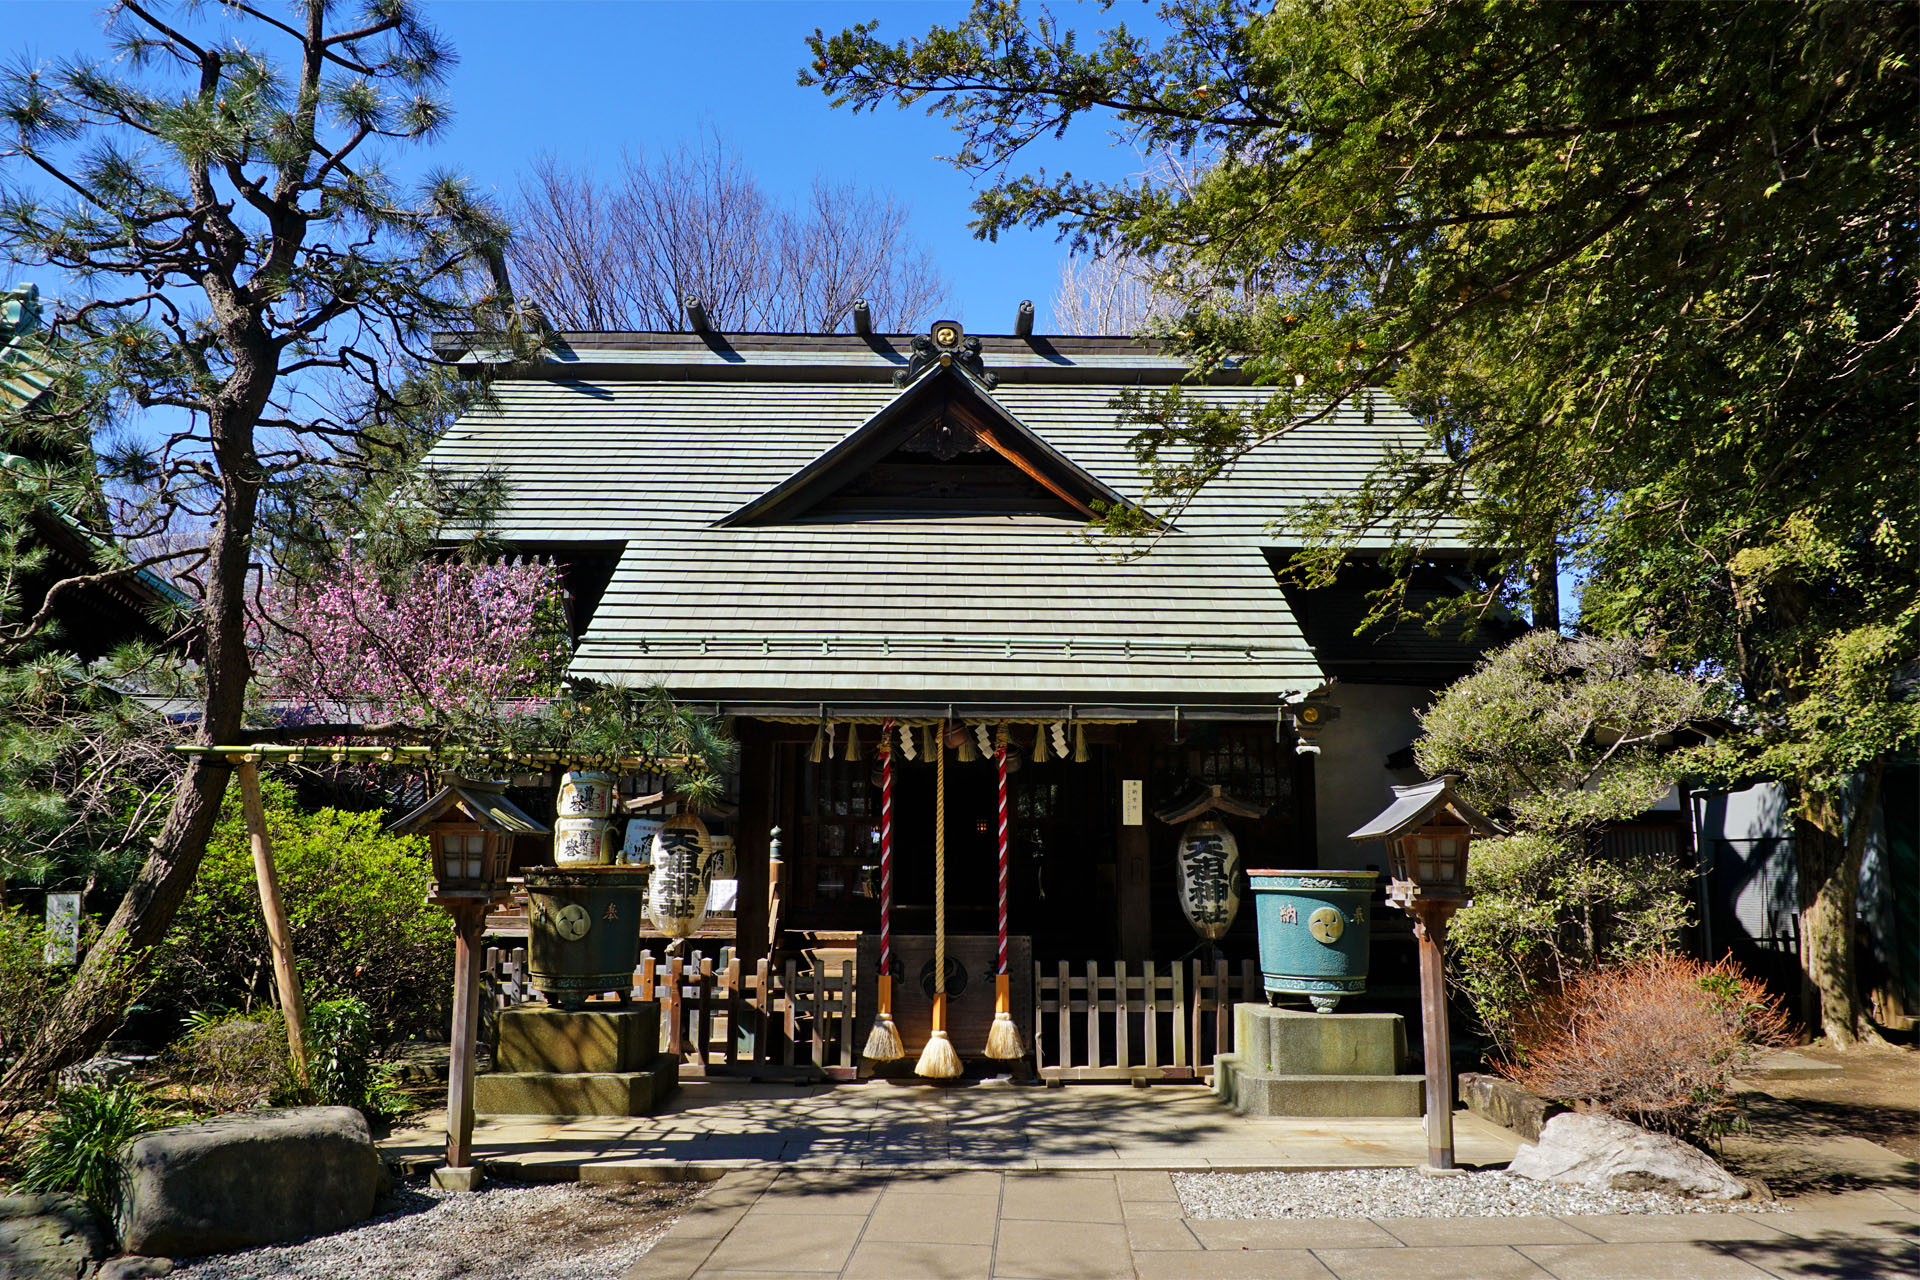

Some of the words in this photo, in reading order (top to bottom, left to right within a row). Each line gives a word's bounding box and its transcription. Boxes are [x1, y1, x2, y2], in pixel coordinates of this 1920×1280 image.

[658, 828, 703, 918] 天祖神社
[1183, 834, 1228, 924] 天祖神社
[1279, 903, 1298, 925] 納
